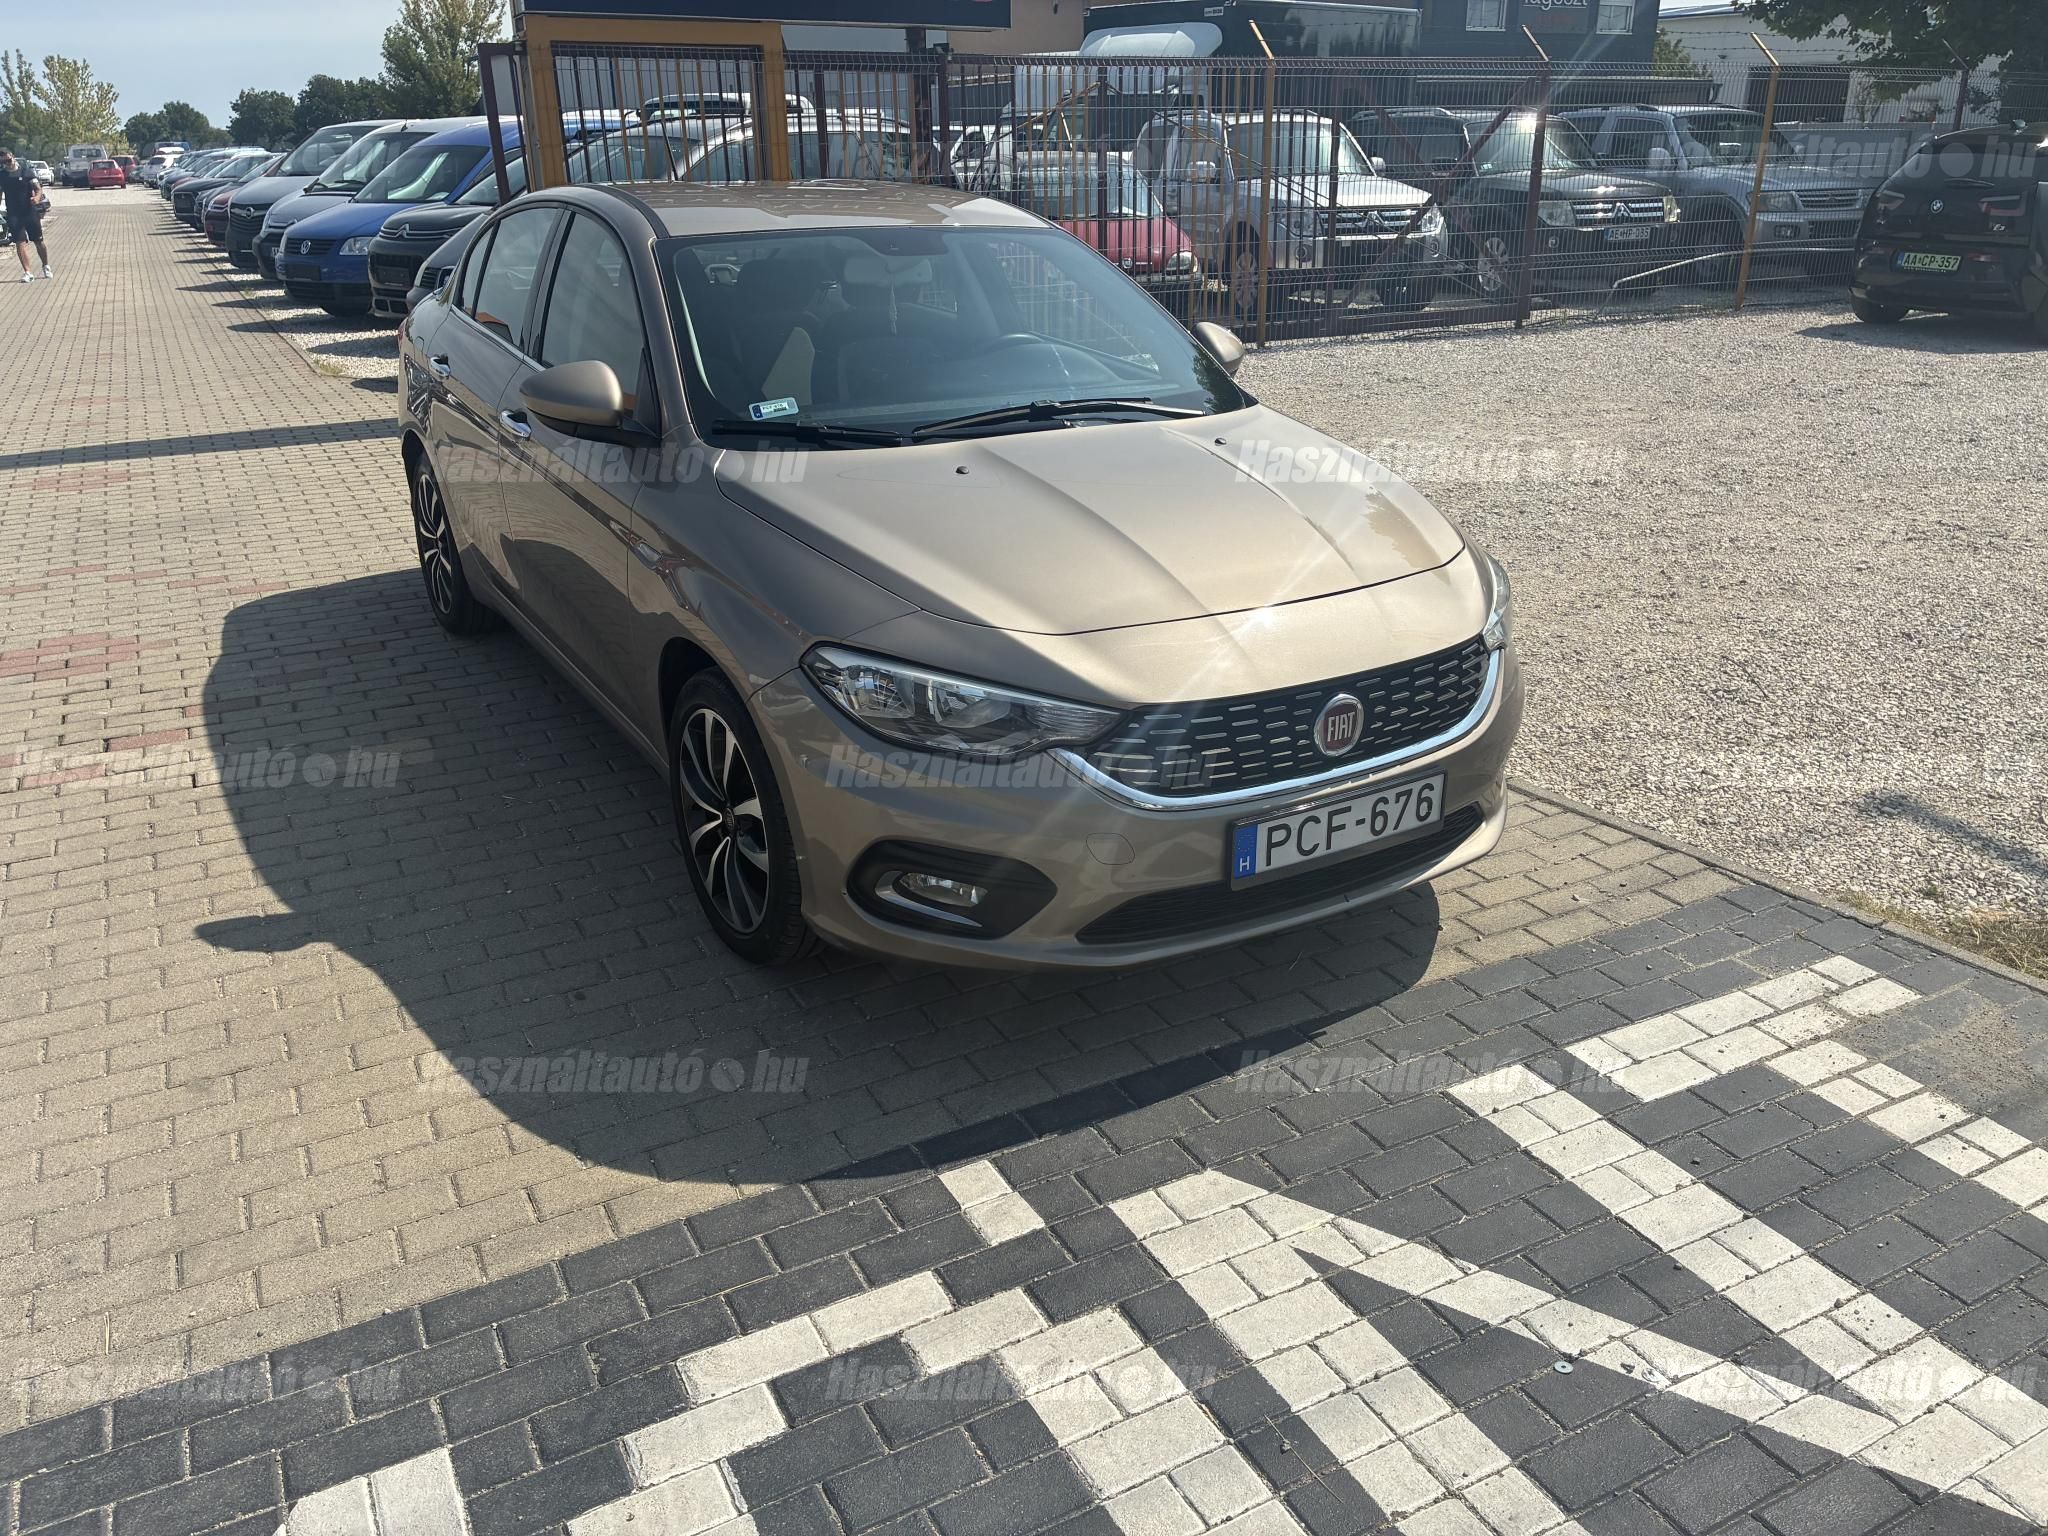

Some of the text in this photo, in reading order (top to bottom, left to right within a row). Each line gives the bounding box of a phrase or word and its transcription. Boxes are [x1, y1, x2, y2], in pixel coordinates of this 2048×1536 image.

[1327, 711, 1356, 742] FIAT
[1239, 782, 1435, 874] H PCF-676
